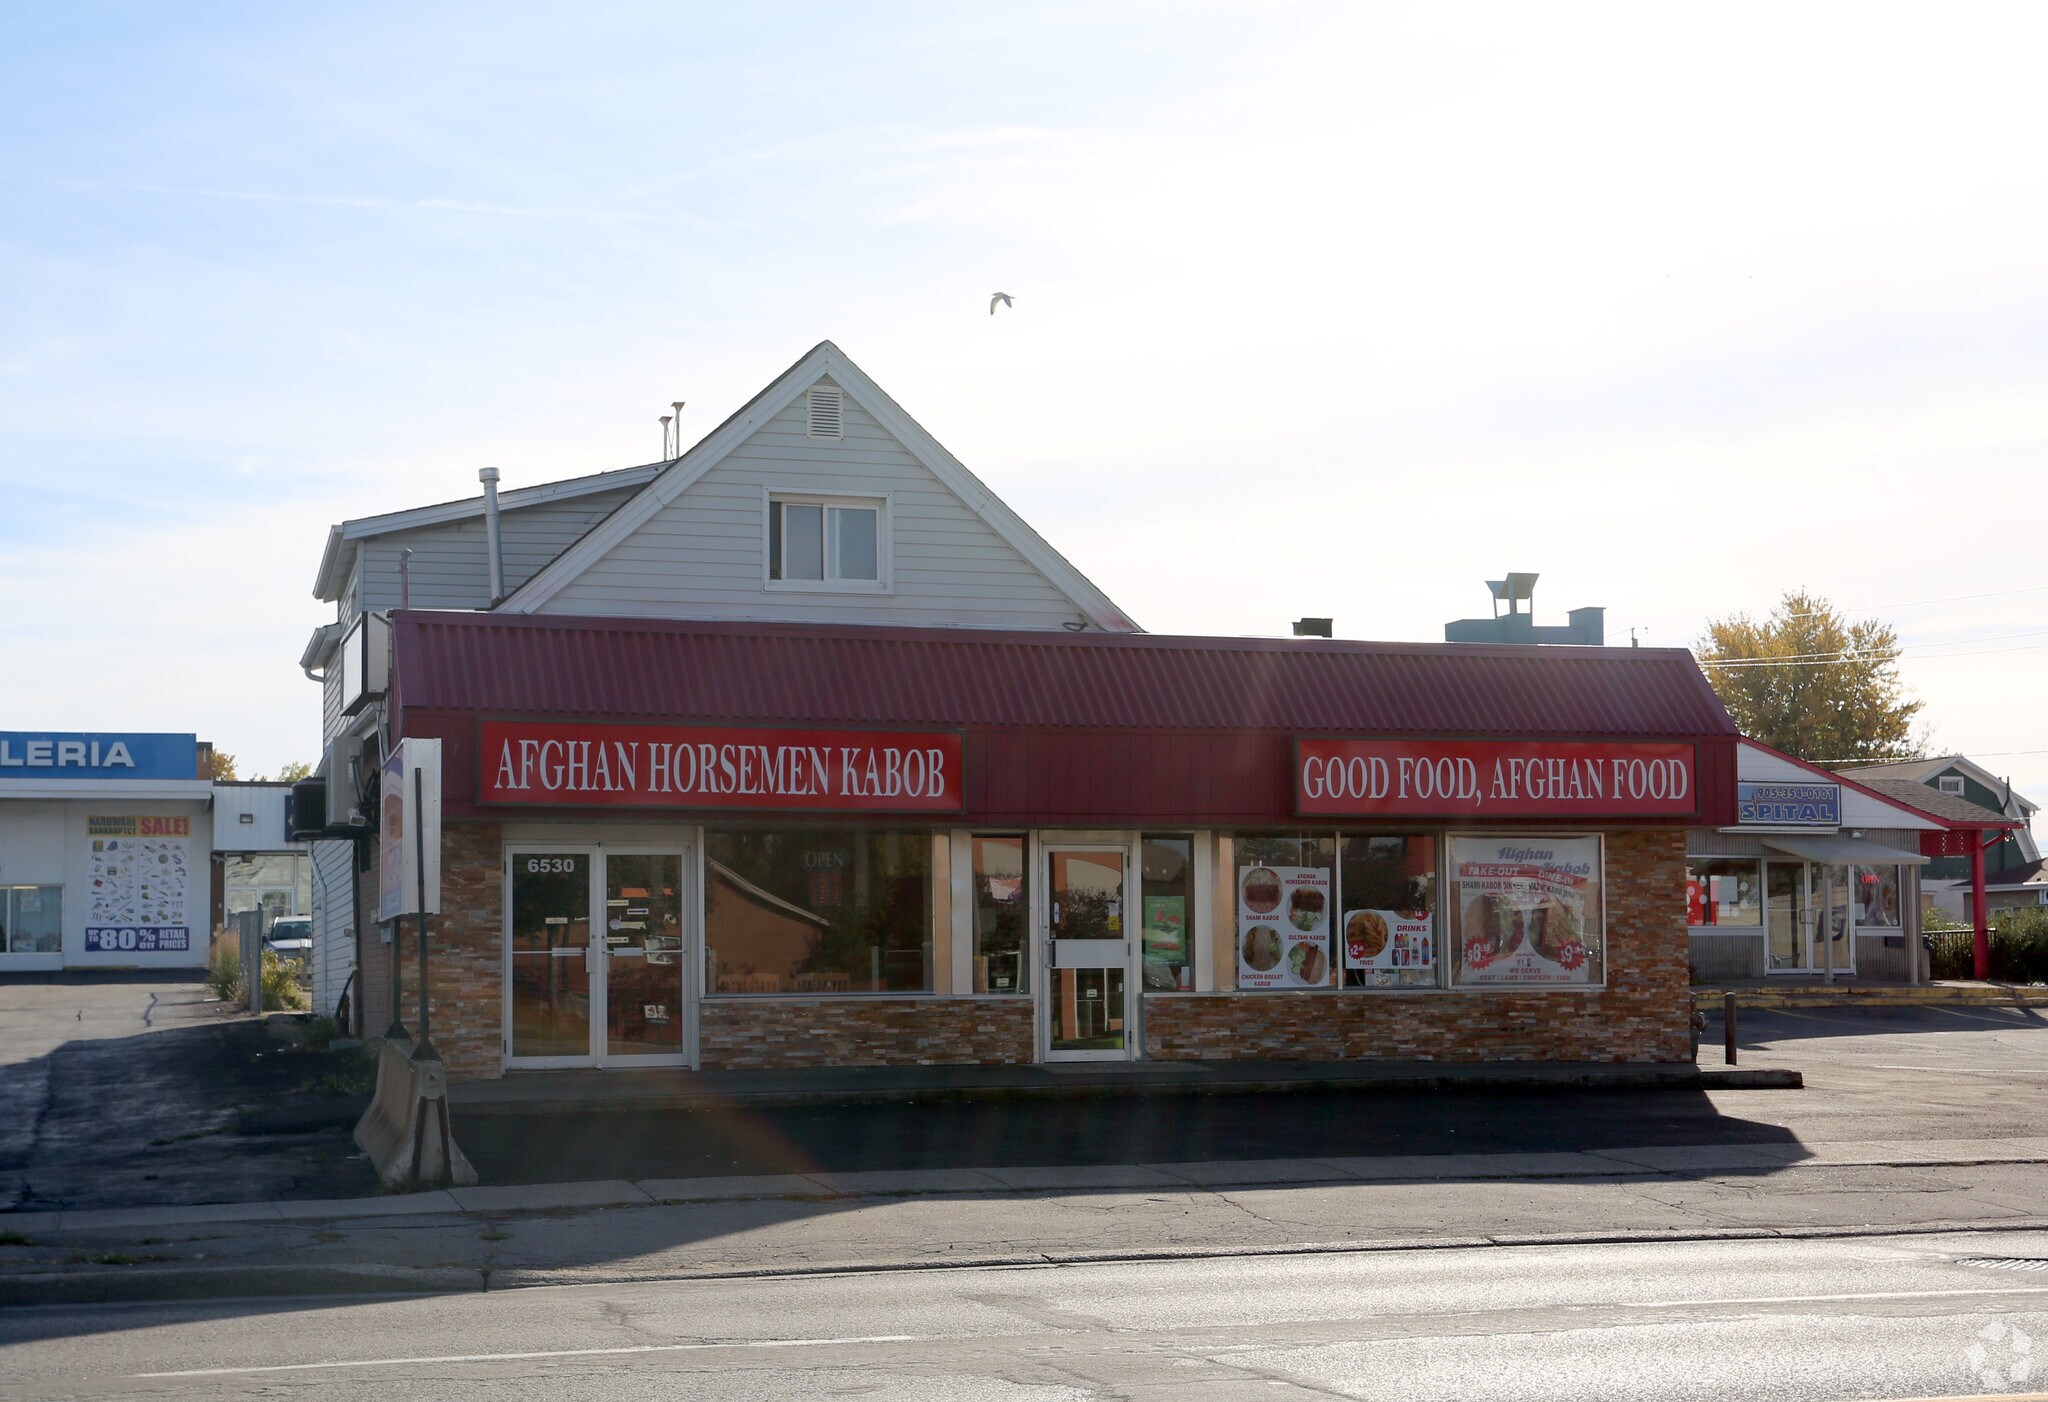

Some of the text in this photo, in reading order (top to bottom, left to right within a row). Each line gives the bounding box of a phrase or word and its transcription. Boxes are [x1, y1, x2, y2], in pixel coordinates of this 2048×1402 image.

[1, 740, 135, 767] LERIA
[494, 738, 945, 797] AFGHAN HORSEMEN KABOB
[1303, 756, 1688, 807] GOOD FOOD, AFGHAN FOOD
[1757, 788, 1834, 800] 905-354-0101
[89, 817, 188, 835] HARDWARE SALE!
[89, 827, 137, 835] BANKRUPTCY
[527, 858, 575, 873] 6530
[805, 851, 844, 868] OPEN
[1467, 866, 1575, 886] TAKE-OUT DINE-IN
[1462, 881, 1481, 889] SHAMI
[1481, 881, 1502, 890] KABOB
[159, 929, 186, 939] RETAIL
[159, 939, 187, 949] PRICES
